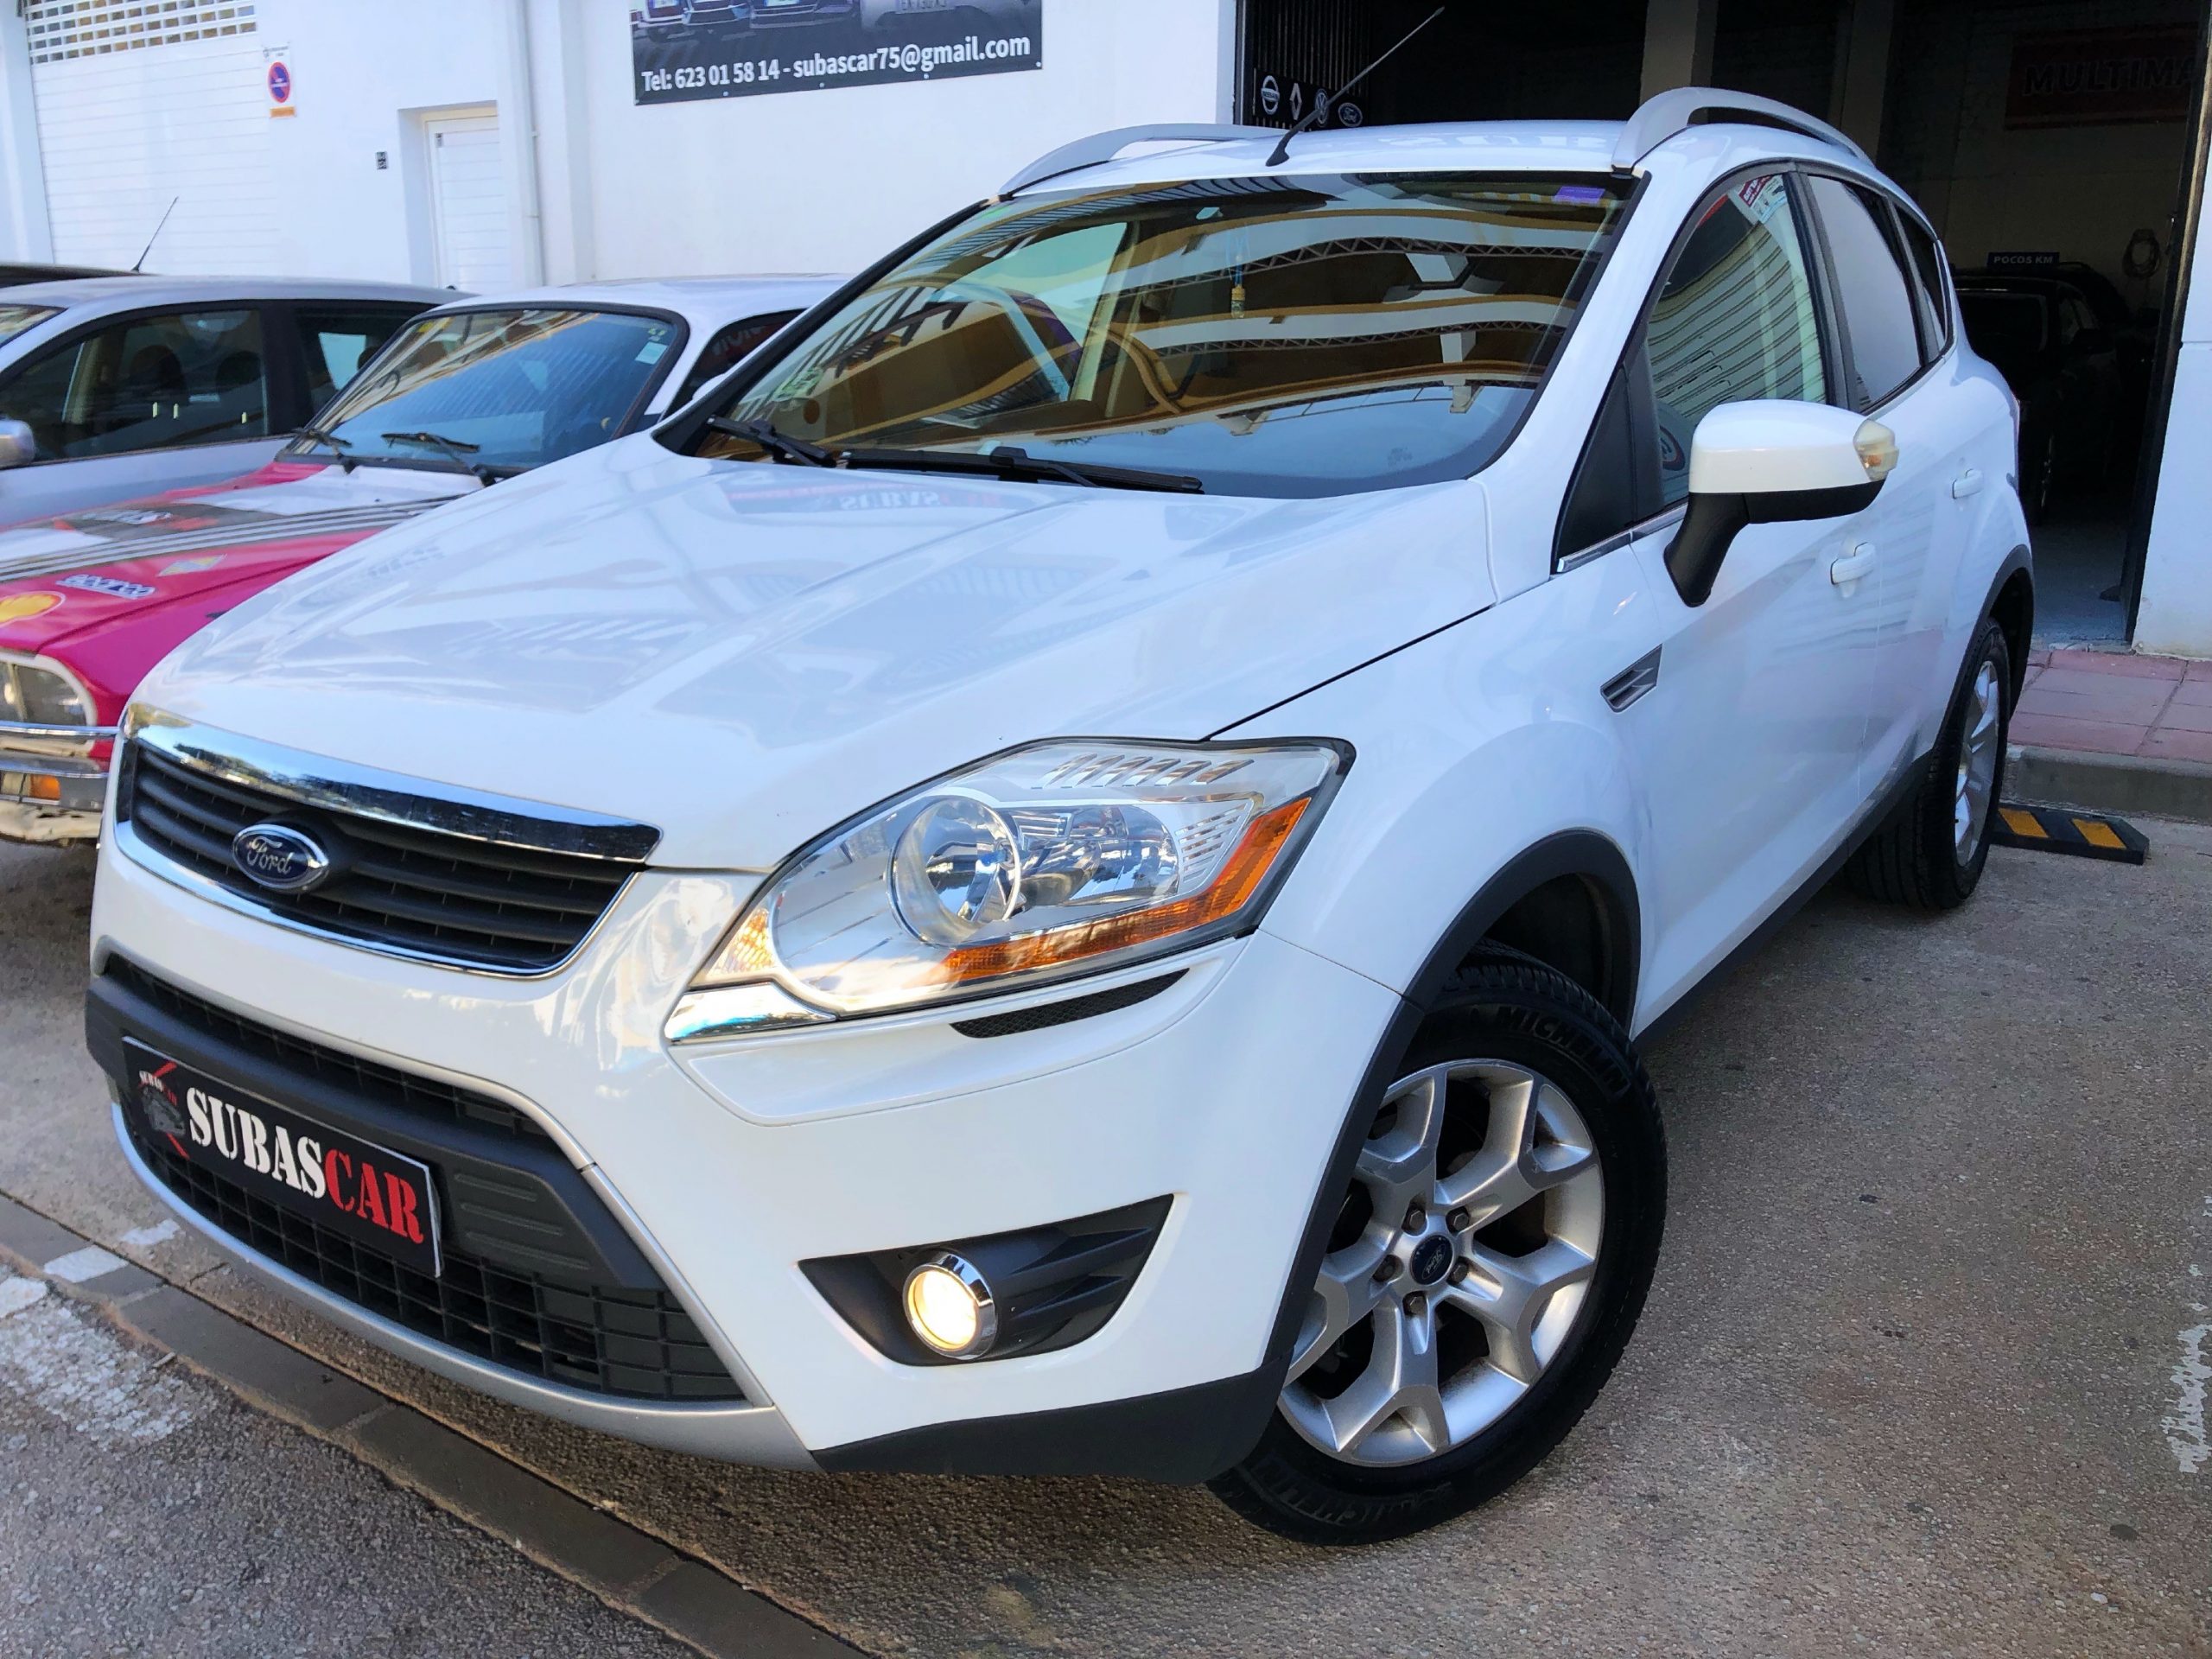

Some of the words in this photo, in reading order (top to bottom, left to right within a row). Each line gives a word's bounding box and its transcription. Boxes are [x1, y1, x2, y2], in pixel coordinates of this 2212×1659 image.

[641, 68, 672, 91] Tel:
[675, 67, 706, 88] 623
[708, 65, 730, 86] 01
[733, 61, 754, 83] 58
[758, 59, 780, 81] 14
[793, 36, 1030, 78] subascar75@gmail.com
[246, 836, 295, 874] Ford
[186, 1087, 424, 1244] SUBASCAR
